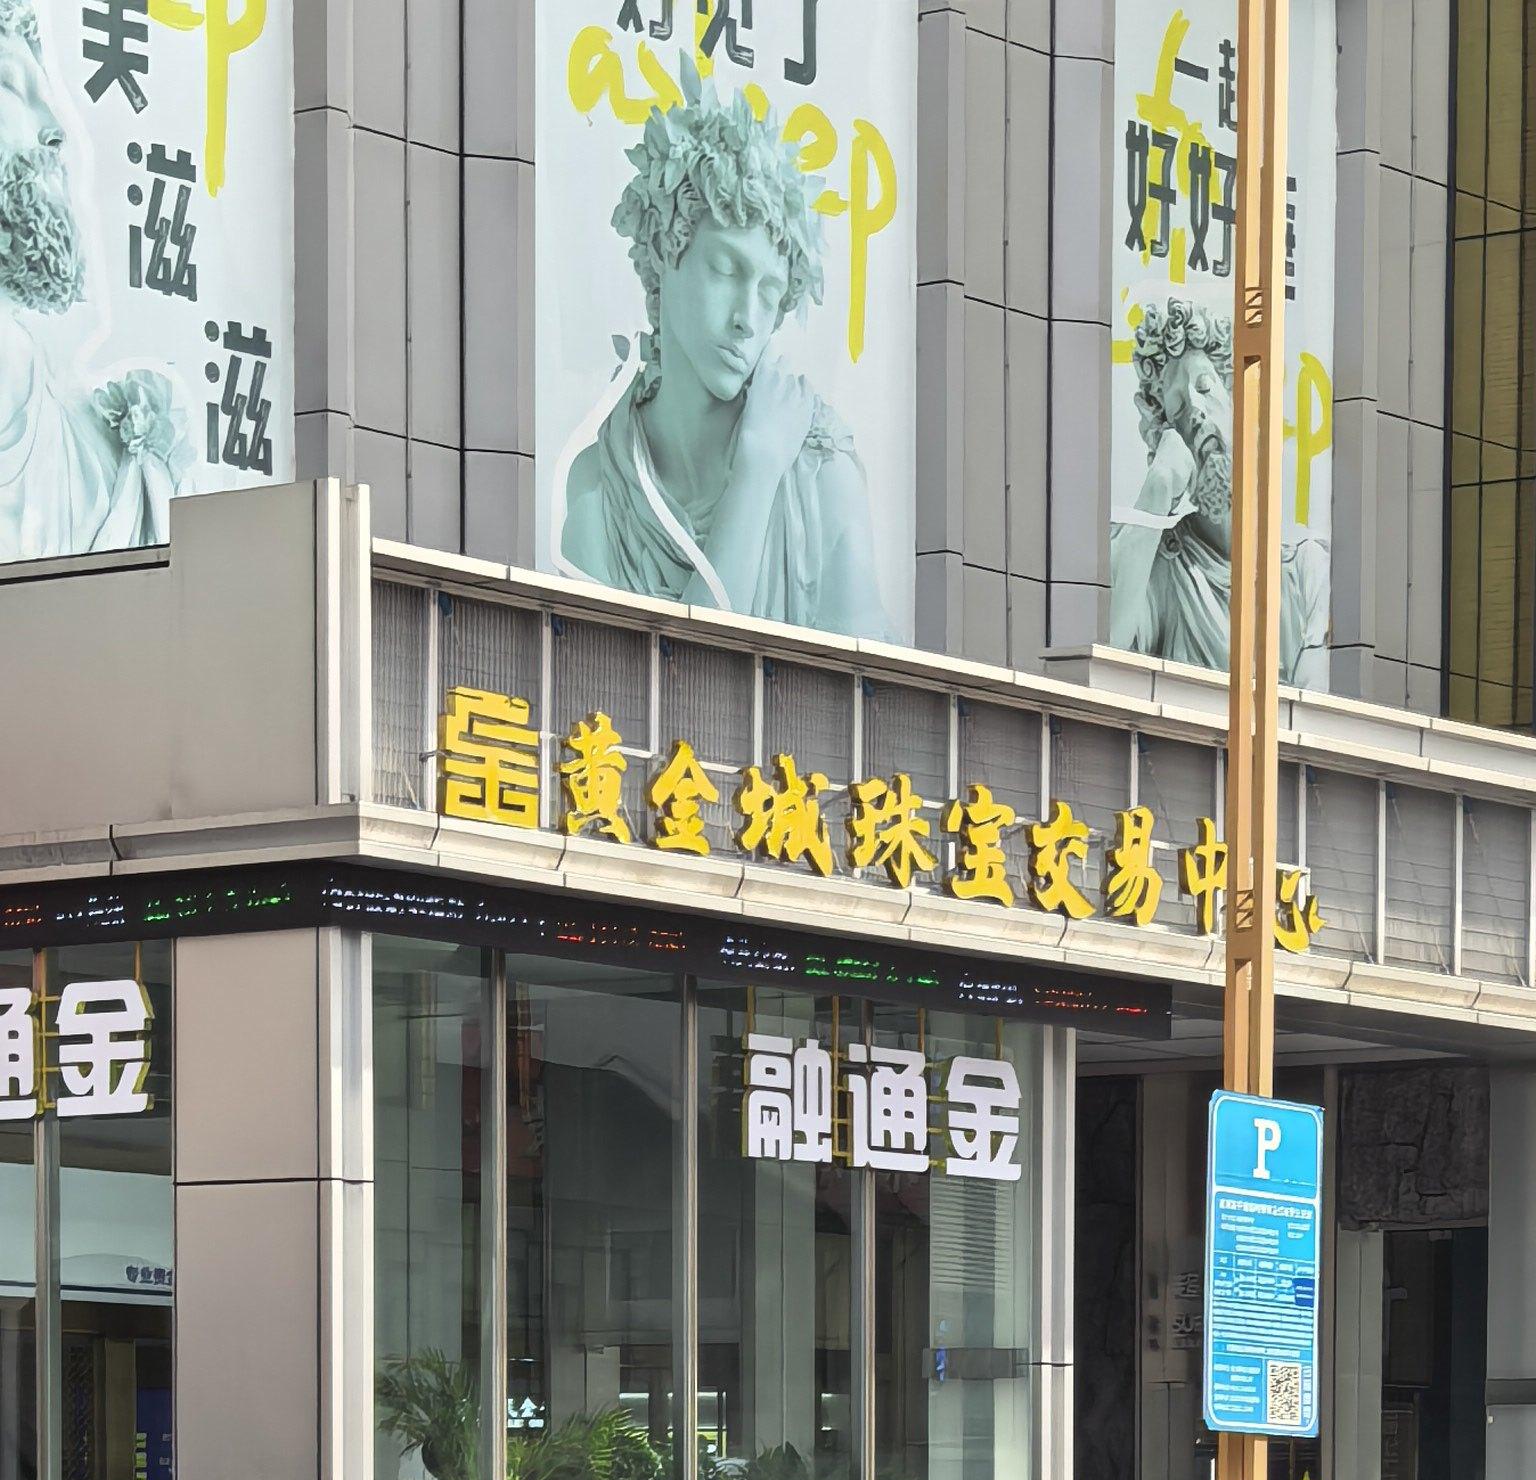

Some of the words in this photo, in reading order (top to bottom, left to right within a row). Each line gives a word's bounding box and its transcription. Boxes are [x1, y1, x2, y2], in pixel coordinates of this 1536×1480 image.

[1124, 119, 1298, 302] 好好
[559, 711, 1328, 954] 黄金城珠宝交易中心
[743, 1032, 1023, 1182] 融通金
[1252, 1117, 1283, 1180] P
